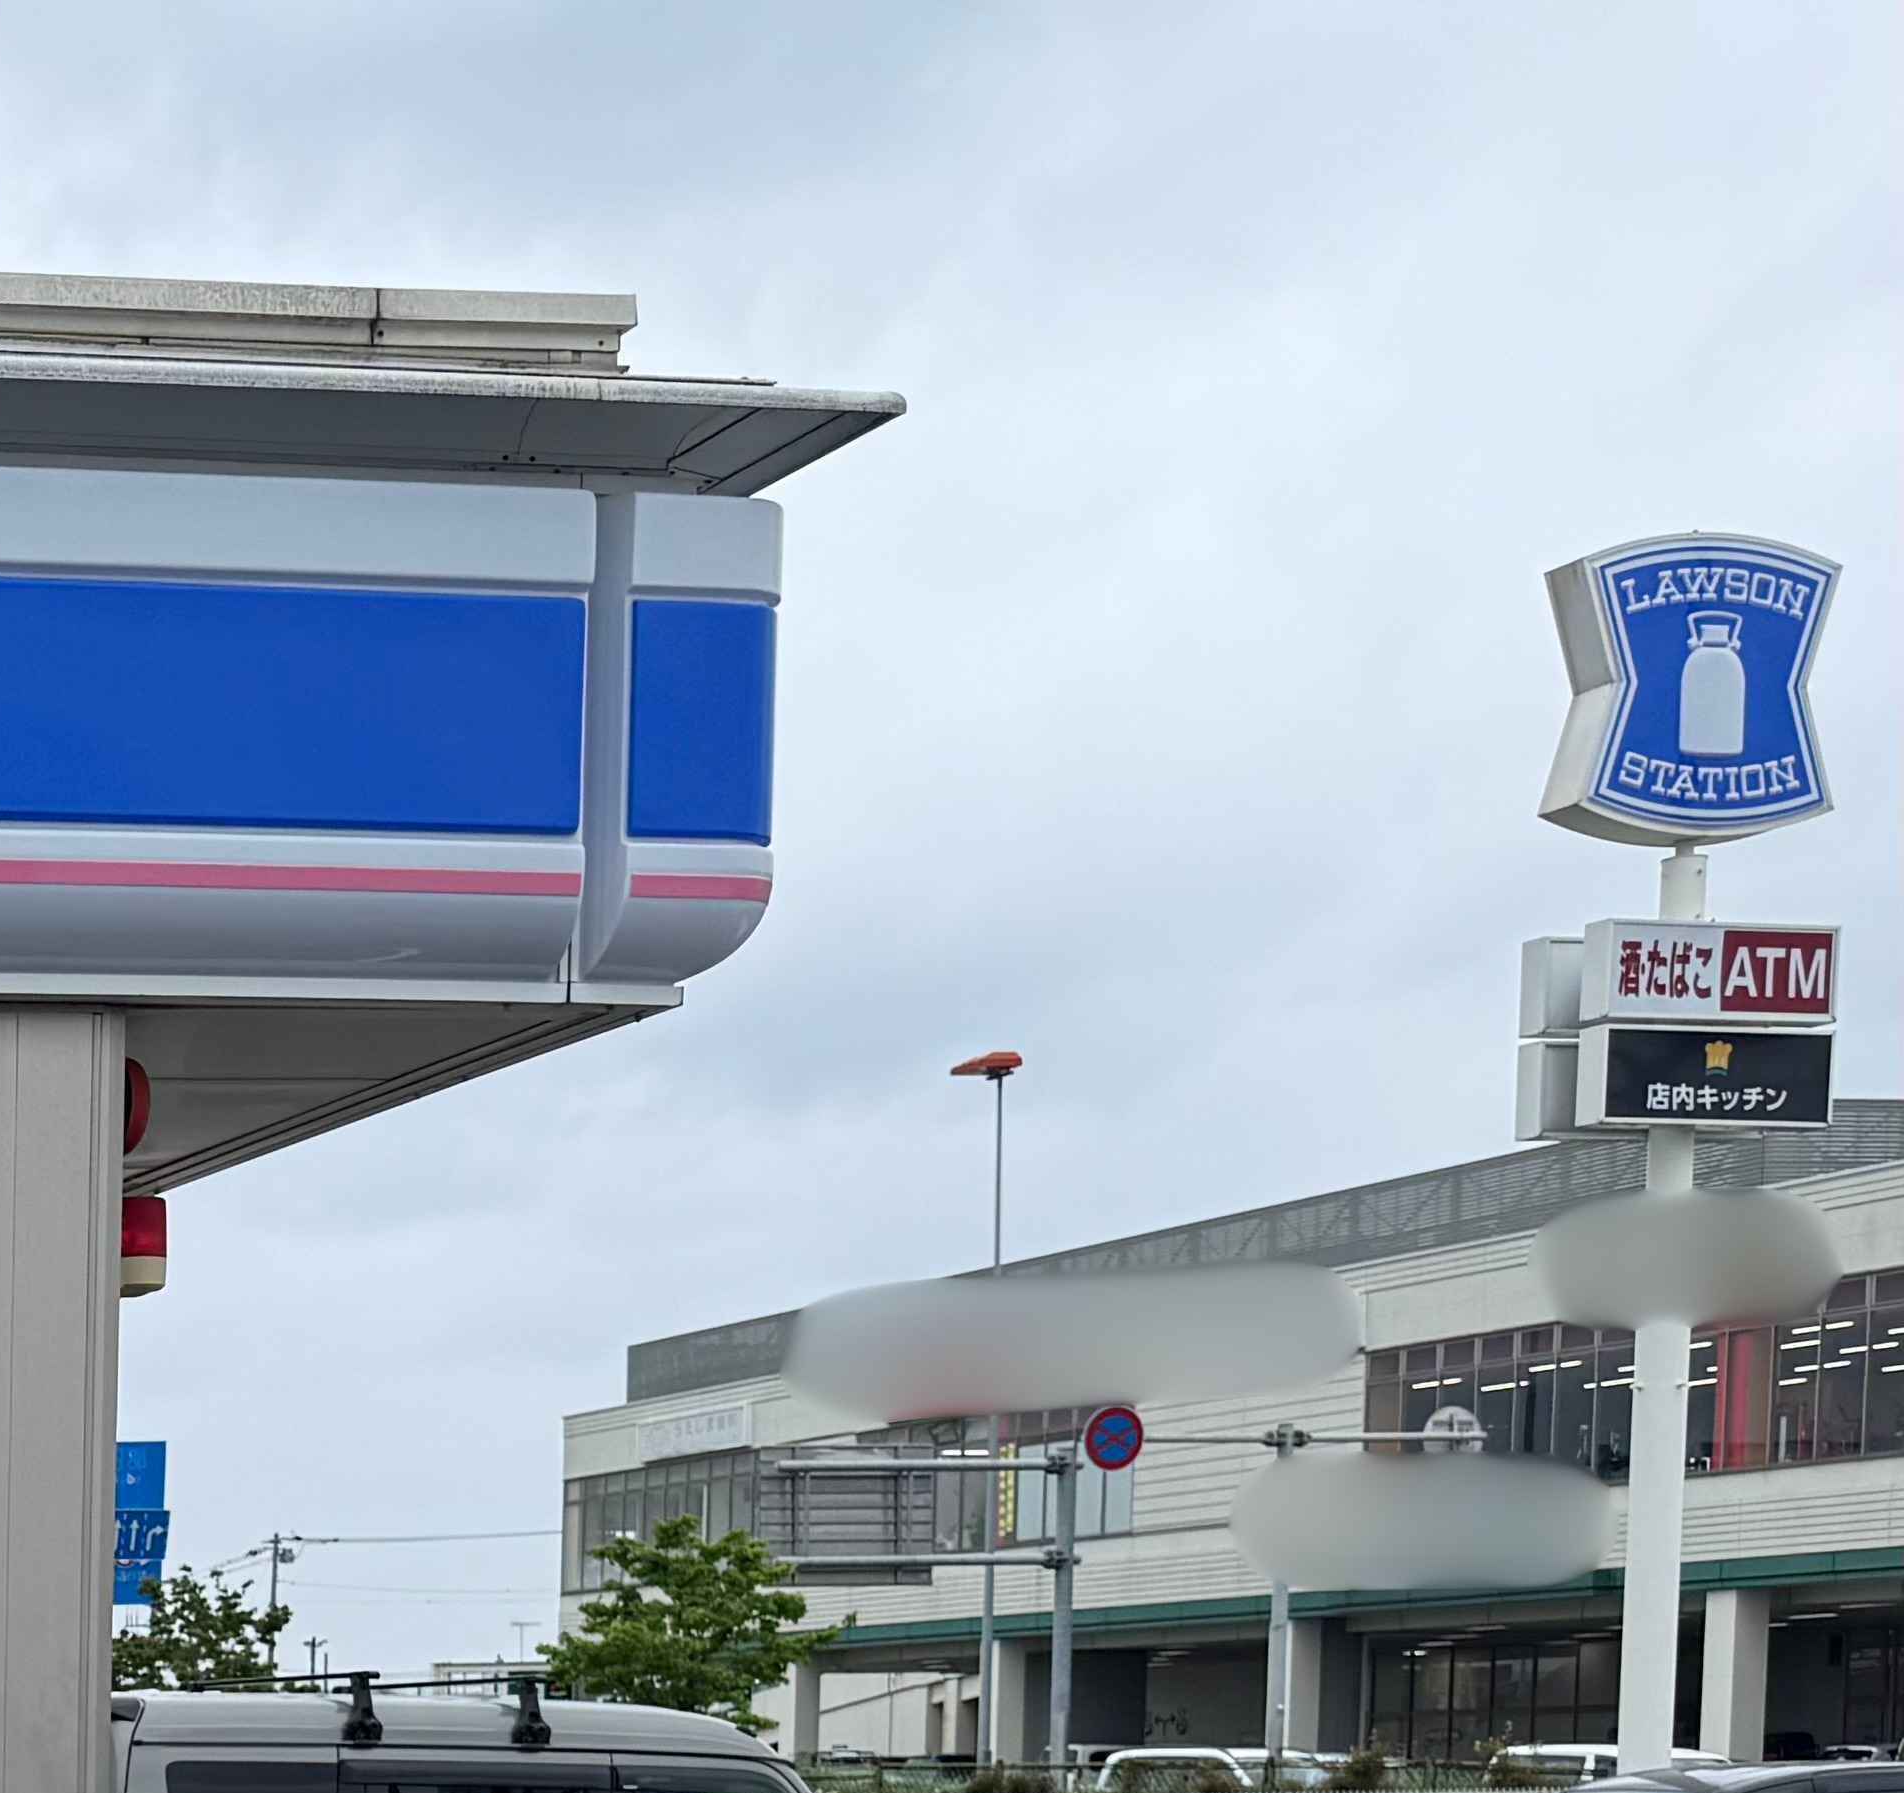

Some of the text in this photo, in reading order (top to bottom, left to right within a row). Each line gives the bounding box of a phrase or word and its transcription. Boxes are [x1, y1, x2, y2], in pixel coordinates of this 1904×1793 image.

[1620, 567, 1810, 621] LAWSON
[1618, 750, 1801, 802] STATION
[1724, 946, 1827, 999] ATM
[1646, 1082, 1787, 1112] 店内キッチン
